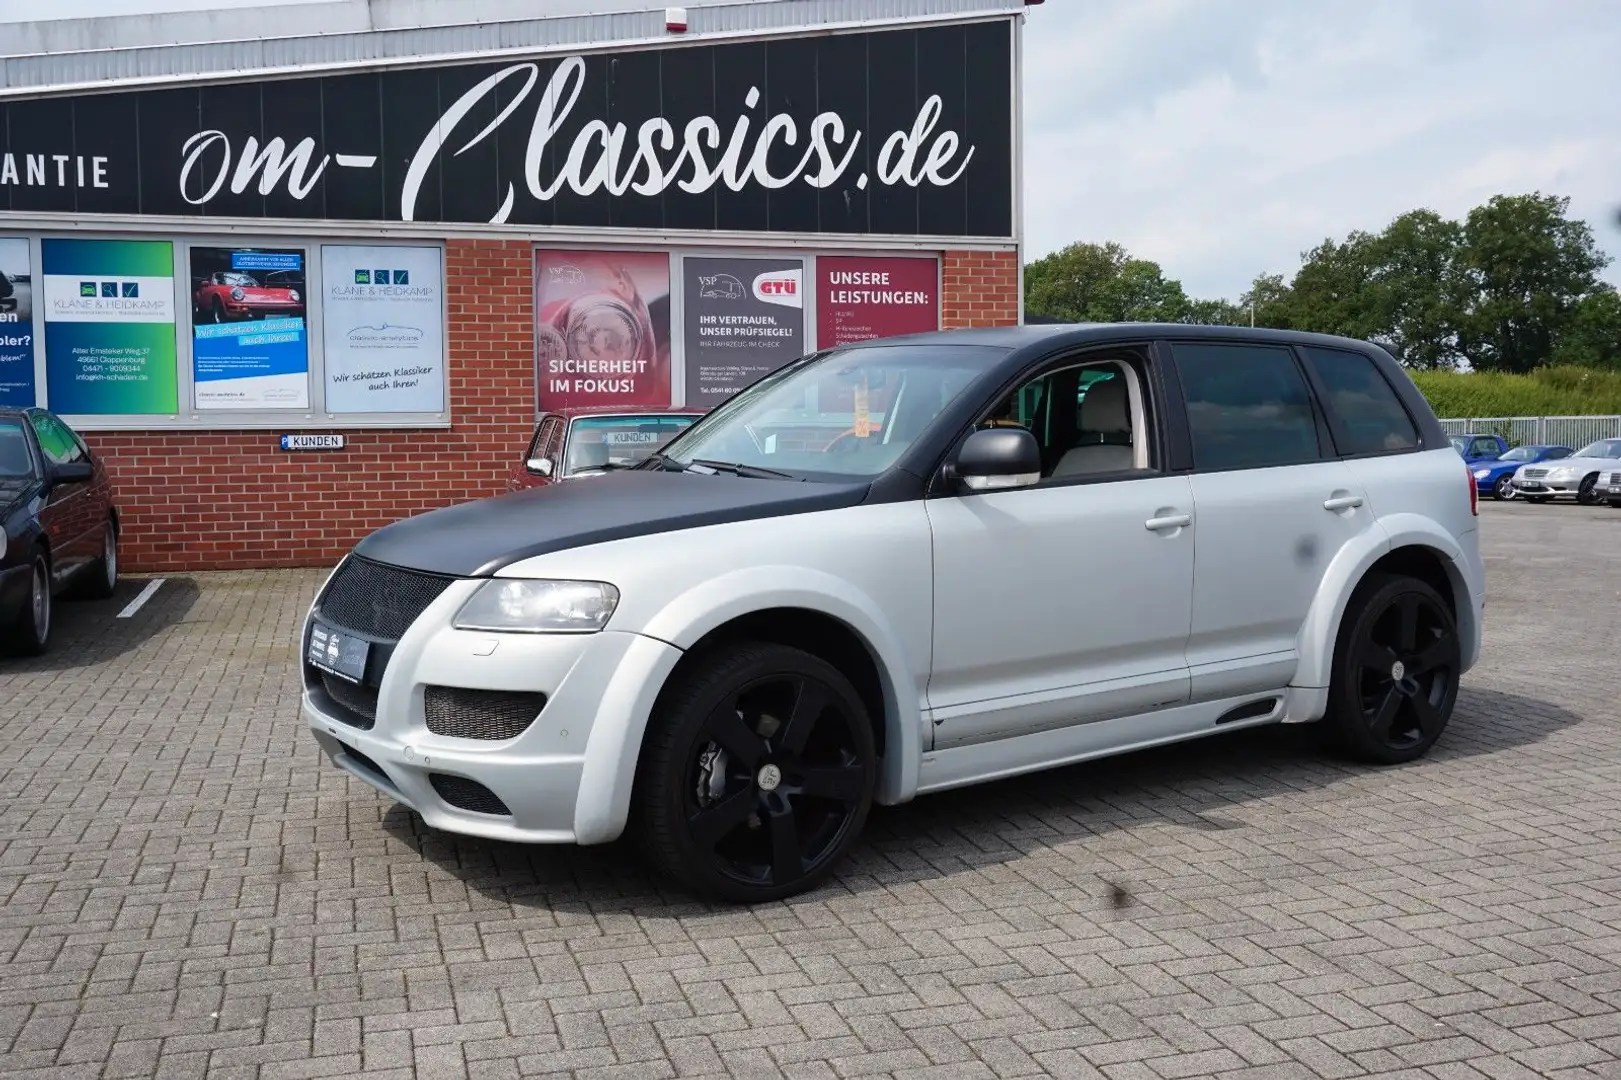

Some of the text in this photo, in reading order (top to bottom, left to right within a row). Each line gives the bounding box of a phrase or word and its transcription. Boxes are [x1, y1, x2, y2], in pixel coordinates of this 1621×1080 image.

[698, 276, 718, 286] VSP
[830, 271, 890, 285] UNSERE
[760, 278, 797, 295] GTÜ
[830, 290, 929, 304] LEISTUNGEN:
[700, 315, 778, 327] IHR VERTRAUEN,
[700, 325, 793, 338] UNSER PRÜFSIEGEL!
[548, 359, 648, 374] SICHERHEIT
[332, 373, 350, 383] Wir
[393, 365, 433, 377] Klassiker
[368, 379, 419, 391] auch Ihren!
[549, 379, 635, 393] IM FOKUS!
[281, 436, 339, 446] P KUNDEN
[615, 432, 651, 443] KUNDEN
